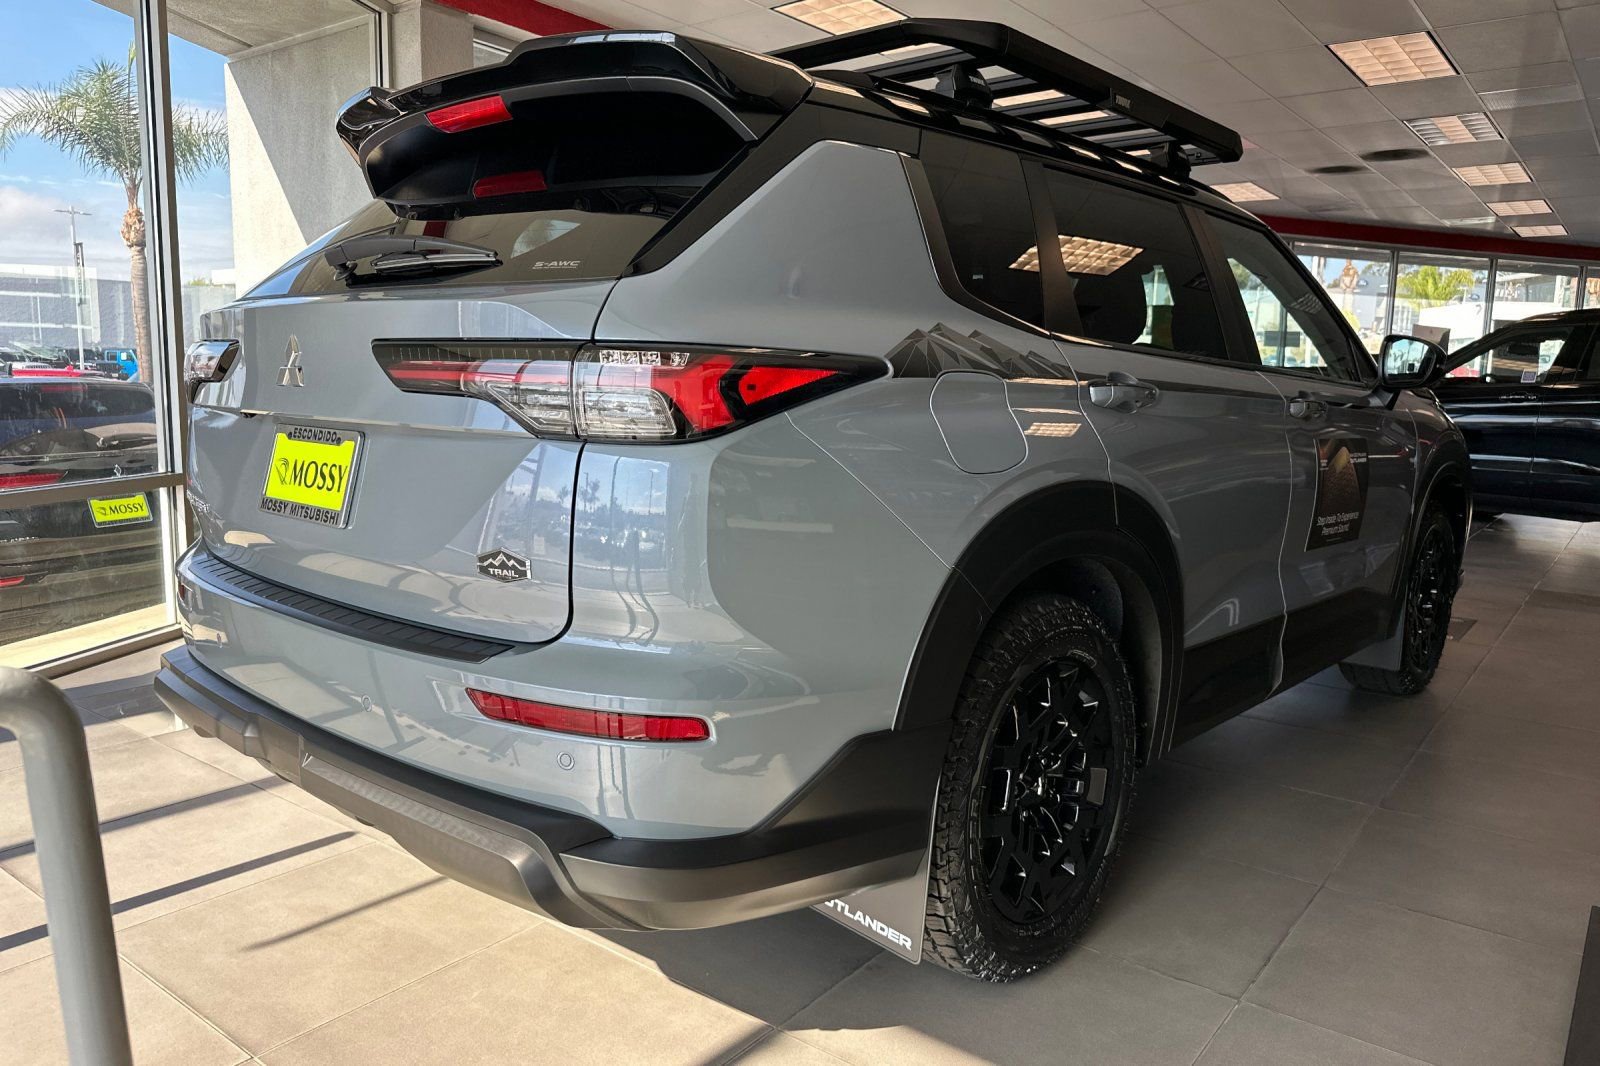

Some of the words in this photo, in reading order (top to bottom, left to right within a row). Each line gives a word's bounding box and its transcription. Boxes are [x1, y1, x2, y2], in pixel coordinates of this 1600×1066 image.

[293, 427, 338, 443] ESCONDIDO
[289, 458, 348, 493] MOSSY
[109, 502, 144, 515] MOSSY
[260, 497, 290, 514] MOSSY
[289, 502, 340, 525] MITSUBISHI
[488, 568, 519, 578] TRAIL
[825, 898, 912, 951] UTLANDER
